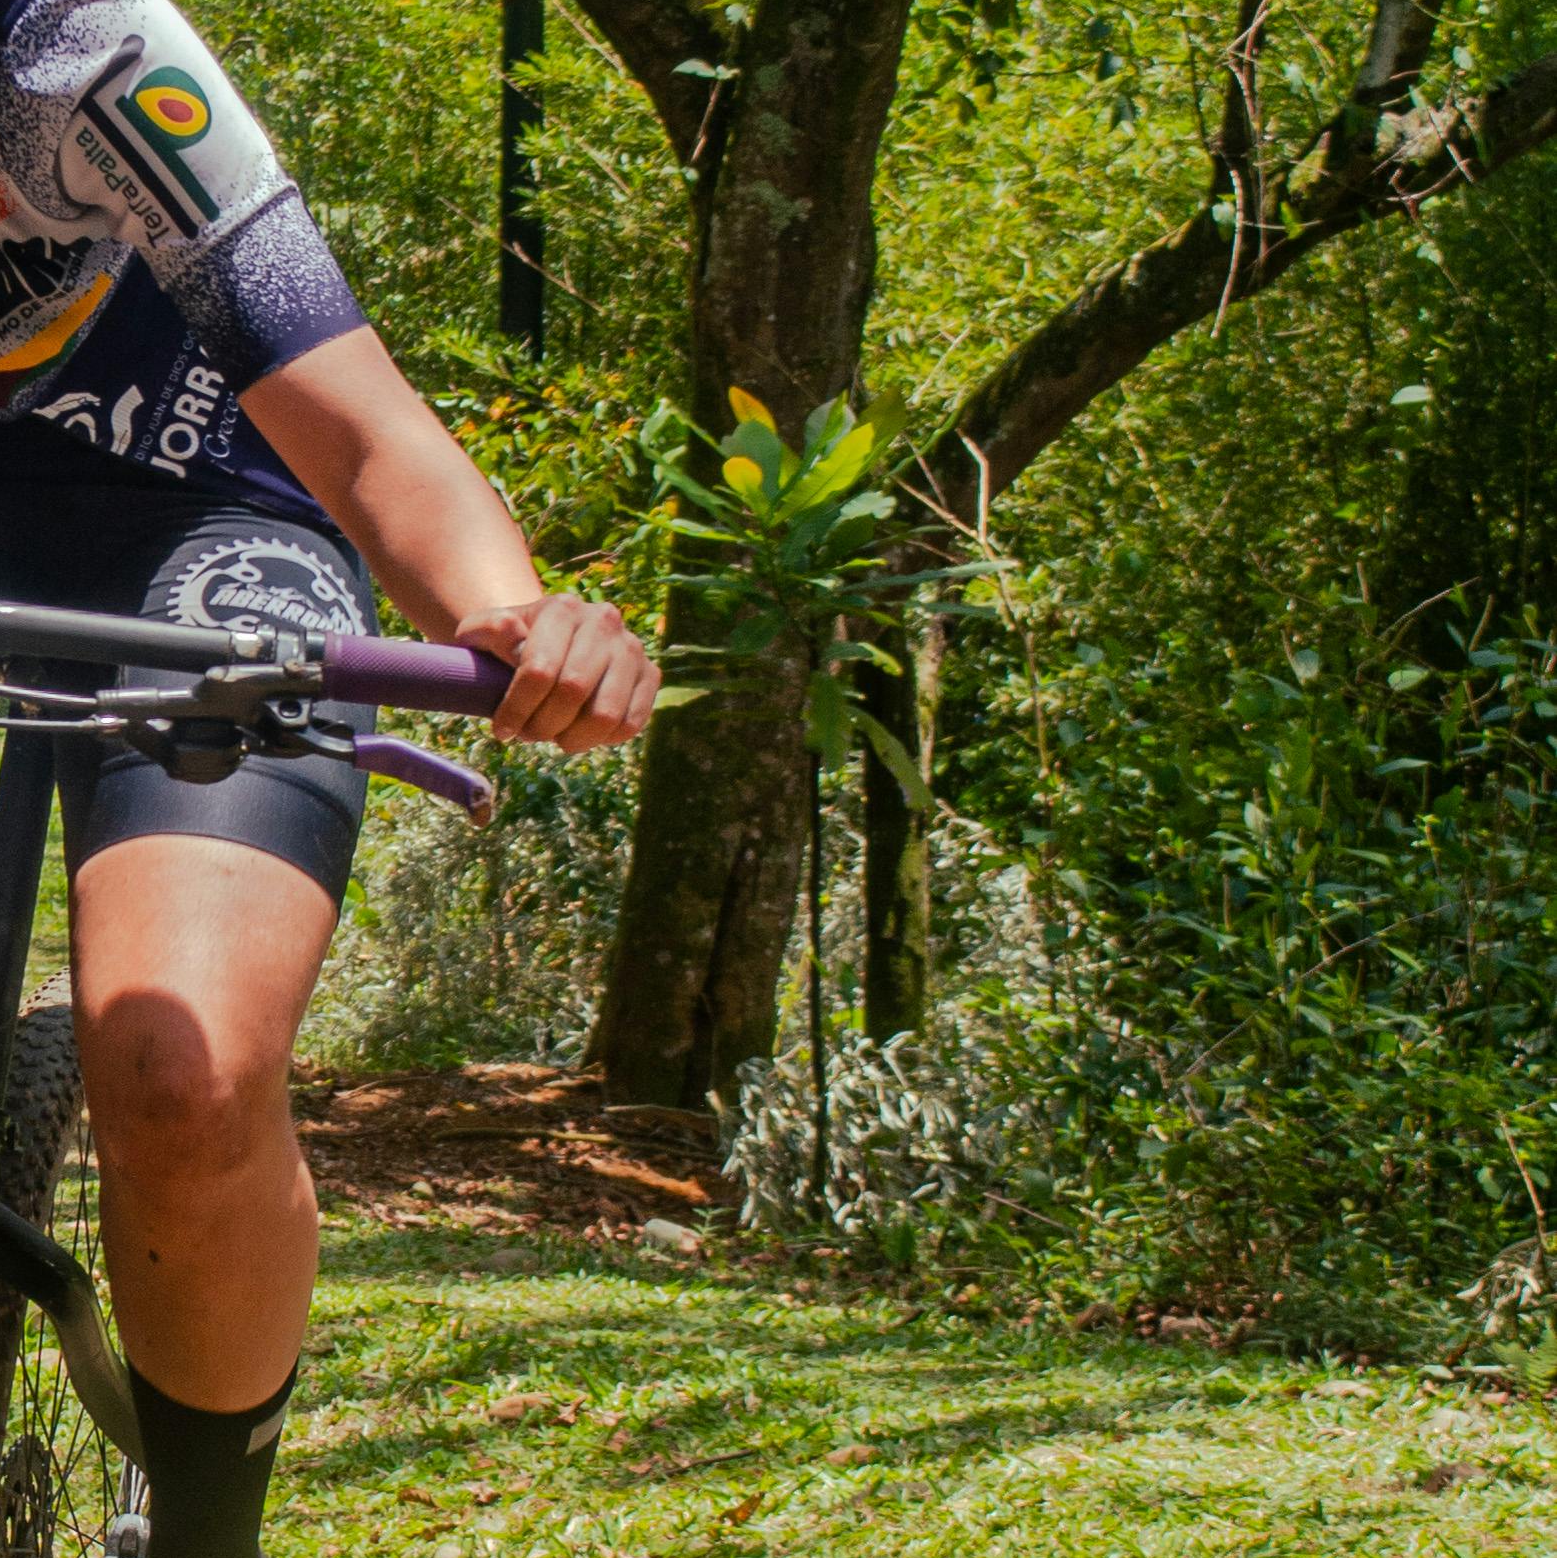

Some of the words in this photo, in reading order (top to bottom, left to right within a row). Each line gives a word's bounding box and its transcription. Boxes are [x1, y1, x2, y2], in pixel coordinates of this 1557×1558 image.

[75, 126, 170, 249] TerraPalta
[19, 299, 43, 320] DE
[147, 403, 168, 434] JUAN
[169, 353, 189, 383] DIOS
[150, 345, 224, 478] JORR
